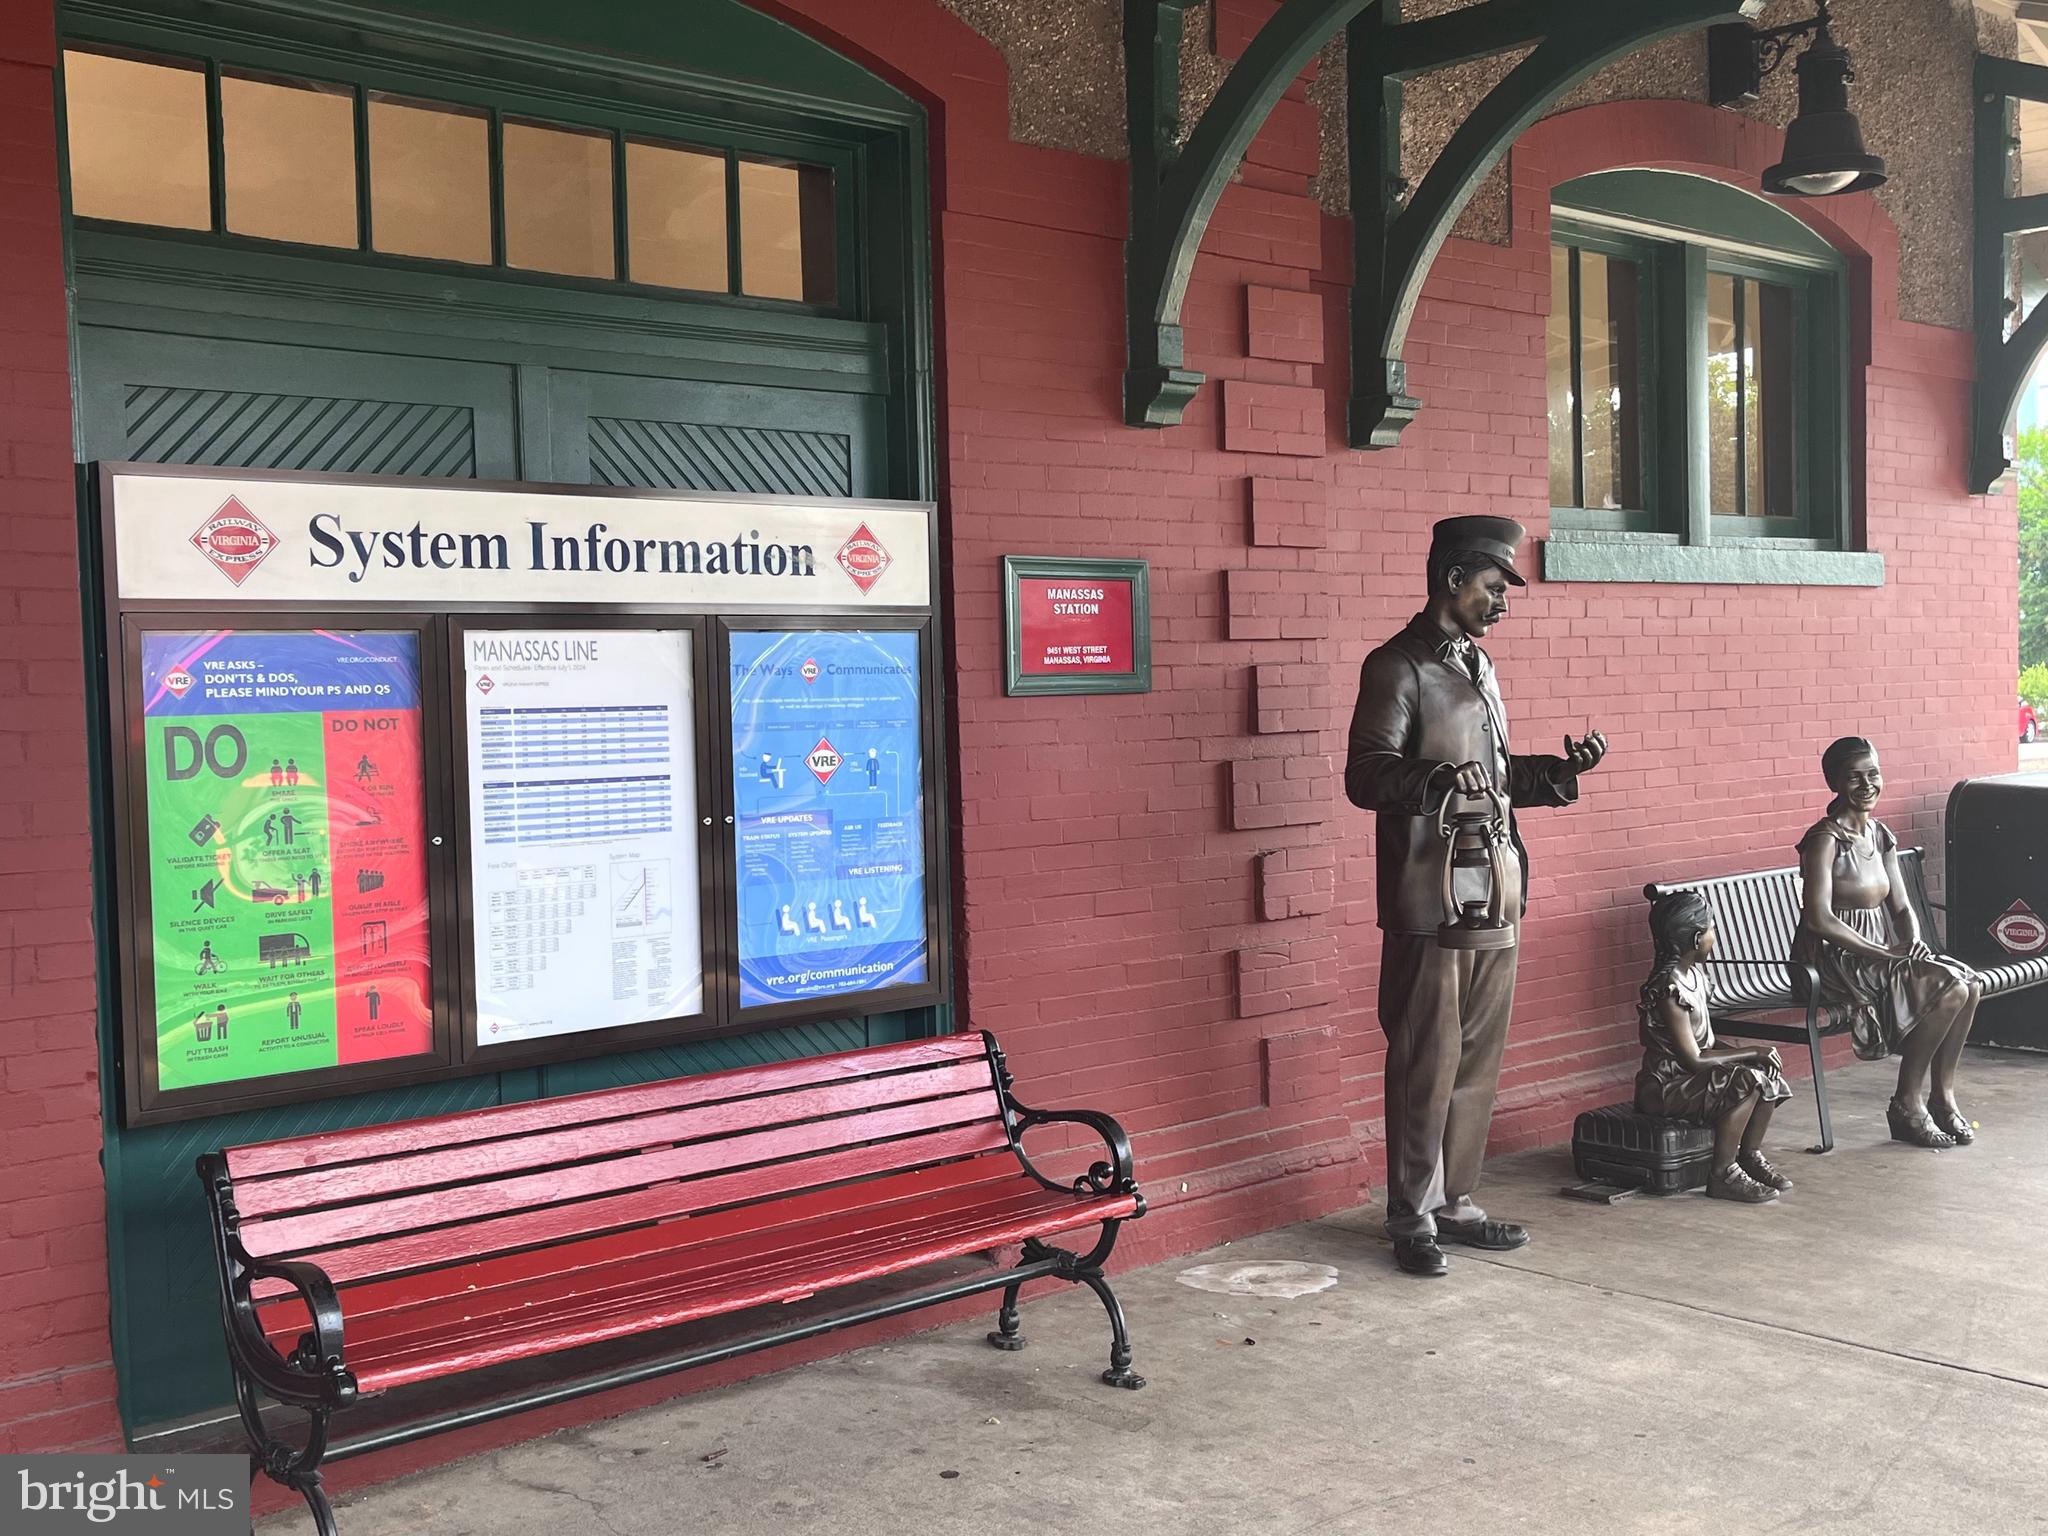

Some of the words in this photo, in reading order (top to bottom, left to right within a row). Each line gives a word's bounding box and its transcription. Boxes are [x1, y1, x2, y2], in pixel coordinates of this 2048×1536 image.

[208, 518, 262, 532] RAILWAY
[210, 535, 260, 546] VIRGINIA
[846, 541, 881, 552] RAILWAY
[308, 513, 512, 583] System
[526, 521, 817, 577] Information
[208, 549, 263, 562] EXPRESS
[848, 554, 880, 564] VIRGINIA
[847, 566, 882, 576] EXPRESS
[1047, 588, 1104, 600] MANASSAS
[1053, 603, 1099, 615] STATION
[473, 640, 560, 662] MANASSAS
[565, 640, 598, 661] LINE
[1062, 646, 1081, 654] WEST
[1082, 646, 1108, 654] STREET
[203, 661, 226, 670] VRE
[227, 660, 256, 670] ASKS
[1044, 656, 1082, 665] MANASSAS,
[1084, 655, 1111, 664] VIRGINIA
[760, 664, 792, 678] Ways
[802, 667, 817, 675] VRE
[826, 664, 912, 676] Communicates
[168, 676, 190, 686] VRE
[204, 674, 254, 684] DON'TS
[257, 673, 267, 684] &
[268, 672, 298, 685] DOS,
[206, 687, 253, 698] PLEASE
[256, 686, 289, 697] MIND
[291, 686, 324, 696] YOUR
[327, 685, 342, 696] PS
[344, 684, 372, 694] AND
[374, 684, 391, 696] QS
[332, 719, 358, 732] DO
[364, 718, 400, 732] NOT
[164, 724, 248, 781] DO
[811, 756, 836, 767] VRE
[760, 816, 777, 824] VRE
[778, 814, 814, 824] UPDATES
[167, 855, 204, 864] VALIDATE
[848, 867, 864, 875] VRE
[864, 864, 903, 874] LISTENING
[288, 908, 314, 916] SAFELY
[170, 920, 202, 928] SILENCE
[204, 916, 236, 925] DEVICES
[259, 974, 278, 982] WAIT
[296, 970, 326, 978] OTHERS
[766, 961, 894, 986] vre.org/communication
[262, 1036, 290, 1046] REPORT
[291, 1032, 326, 1042] UNUSUAL
[186, 1048, 203, 1056] PUT
[204, 1045, 229, 1054] TRASH
